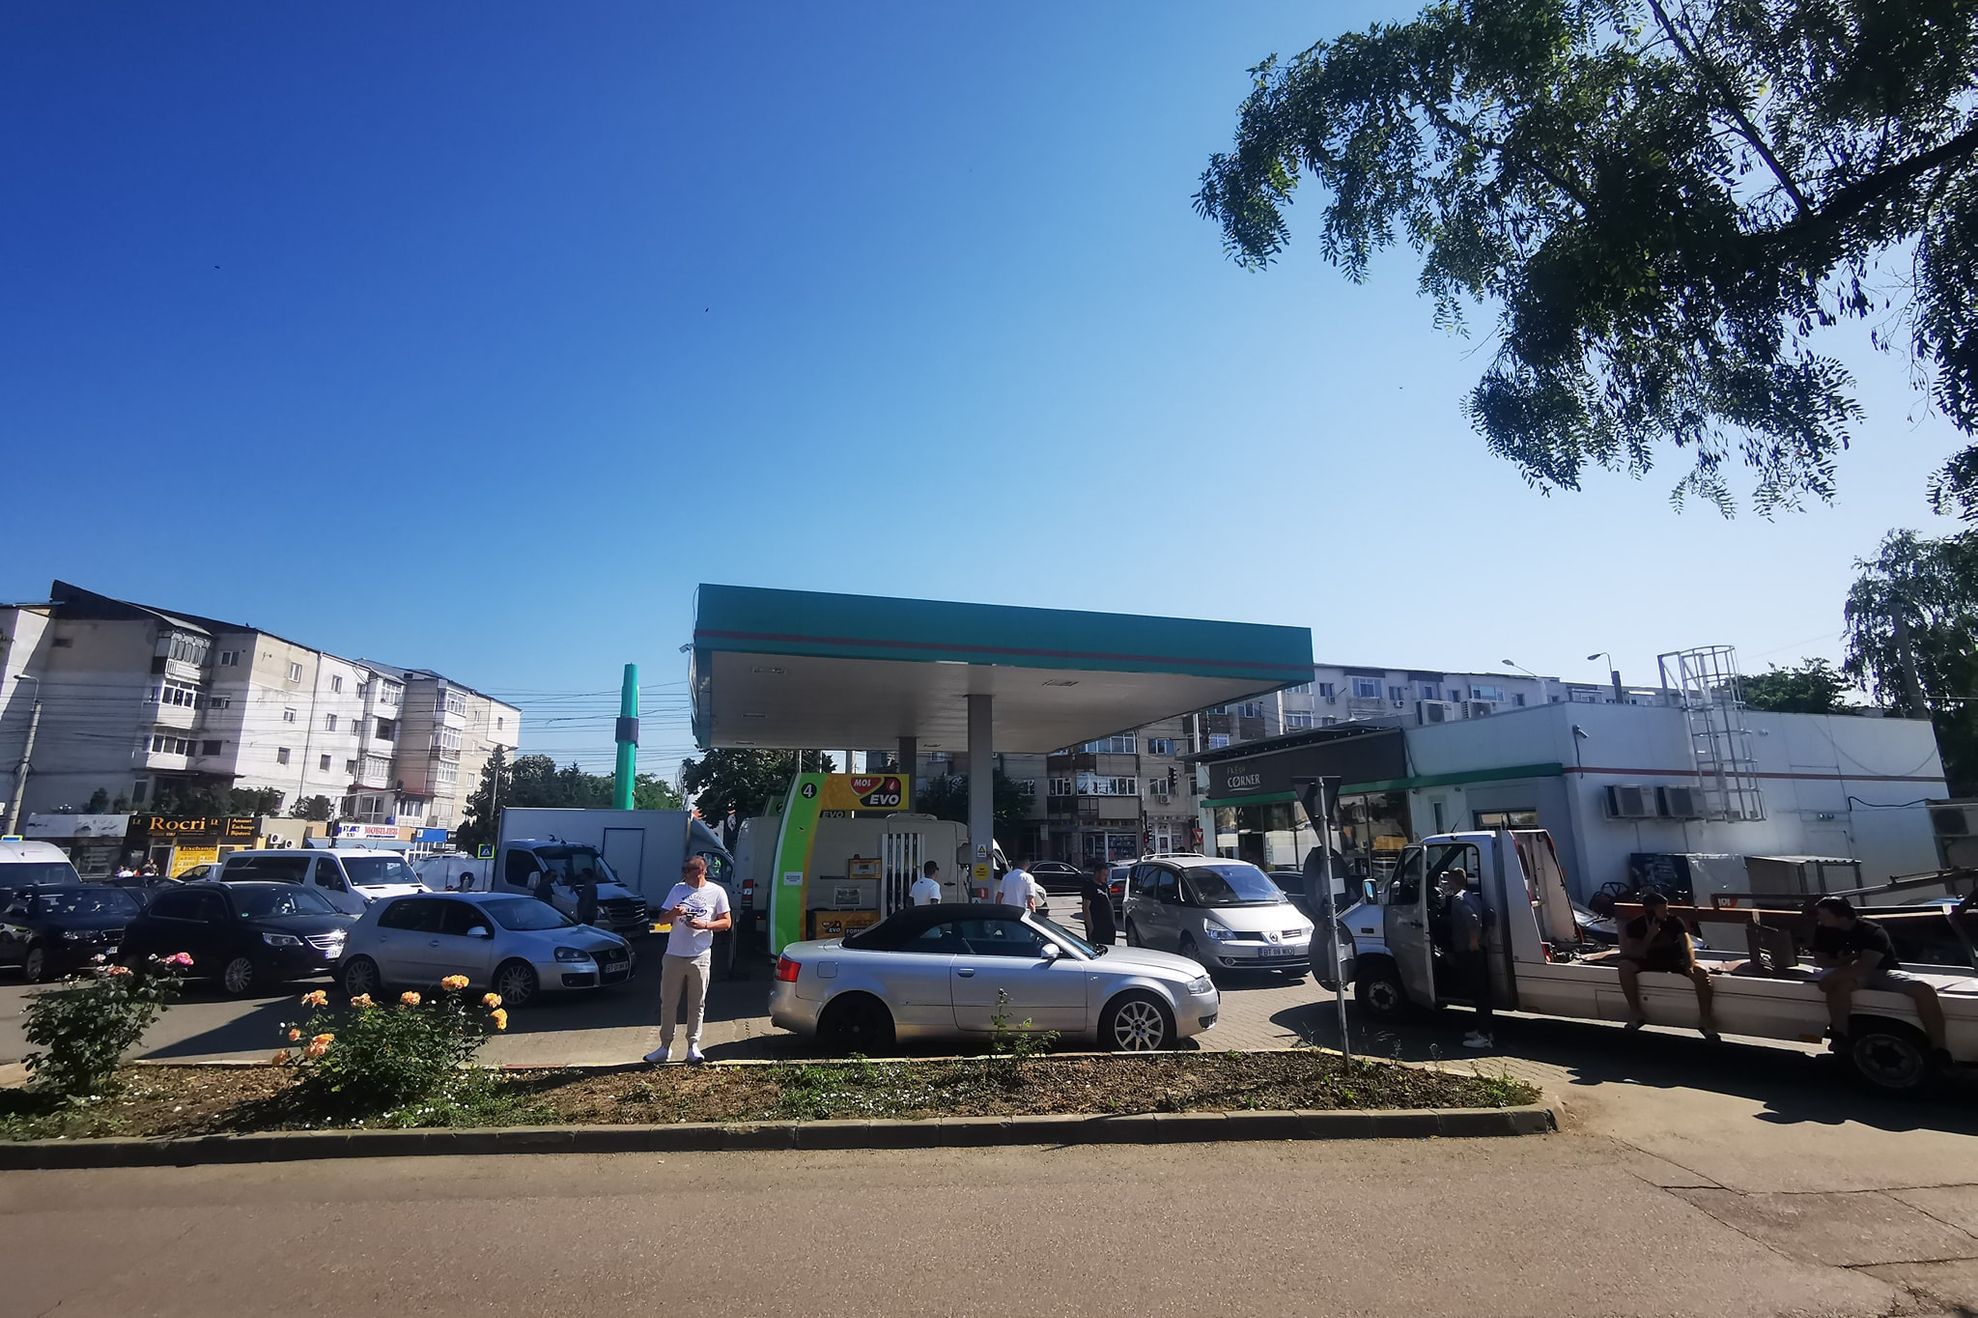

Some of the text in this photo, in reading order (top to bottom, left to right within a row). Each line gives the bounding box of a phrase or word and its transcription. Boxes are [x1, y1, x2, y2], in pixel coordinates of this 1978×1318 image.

[1227, 773, 1261, 788] CORNER
[803, 784, 813, 798] 4
[869, 794, 900, 805] EVO
[149, 816, 206, 831] Rocri
